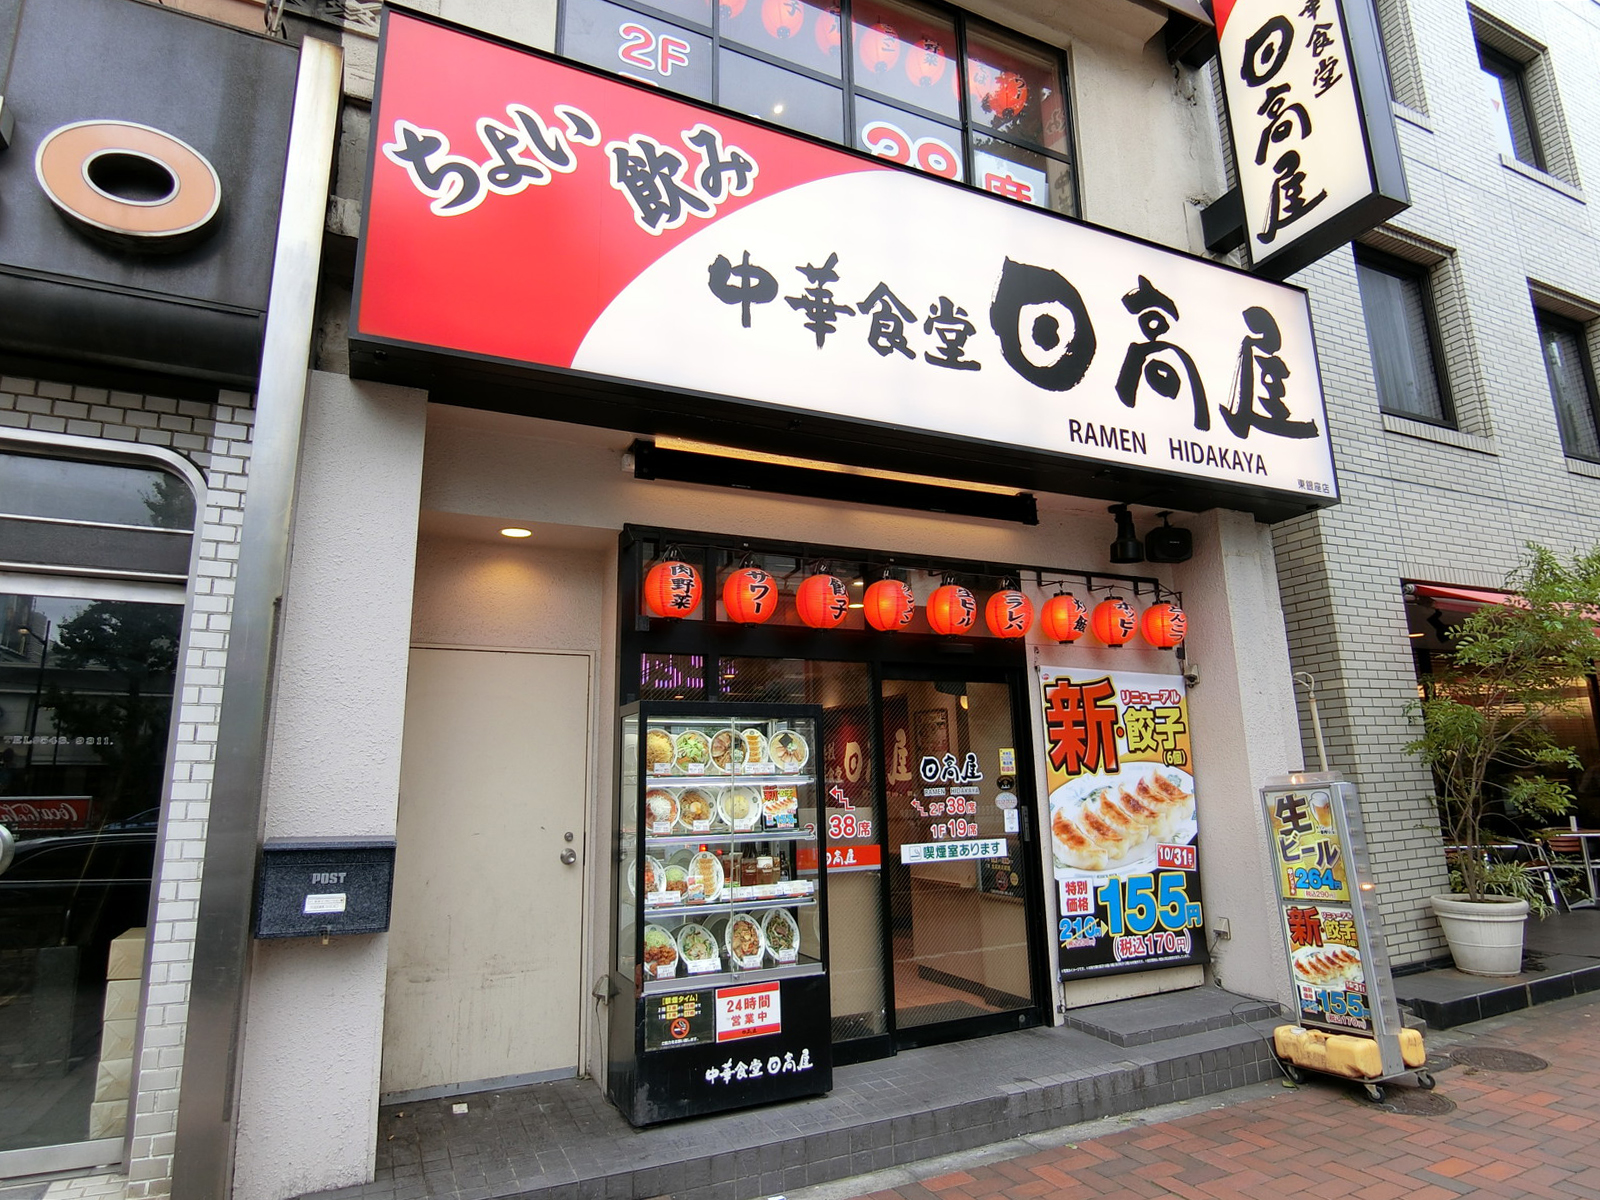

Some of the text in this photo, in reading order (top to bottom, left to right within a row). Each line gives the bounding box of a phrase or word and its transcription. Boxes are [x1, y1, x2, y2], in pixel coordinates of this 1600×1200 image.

[619, 22, 691, 76] 2F
[1240, 15, 1328, 244] 日高屋
[707, 250, 1319, 439] 中華食堂 日高屋
[1069, 418, 1268, 477] RAMEN HIDAKAYA
[1297, 479, 1330, 494] 東銀座店
[670, 563, 695, 609] 肉野菜
[746, 570, 771, 614] サワー
[1121, 690, 1180, 705] リニューアル
[920, 753, 983, 783] 日高屋
[924, 787, 946, 796] RAMEN
[950, 786, 980, 795] HIDAKAYA
[923, 841, 1000, 859] 喫煙室あります
[312, 872, 347, 885] POST
[1065, 880, 1088, 896] 特別
[1295, 867, 1343, 890] 264円
[1066, 897, 1089, 914] 価格
[1099, 871, 1202, 938] 155円
[727, 994, 771, 1013] 24時間
[730, 1011, 768, 1027] 営業中
[705, 1048, 813, 1085] 中華食堂 日高屋
